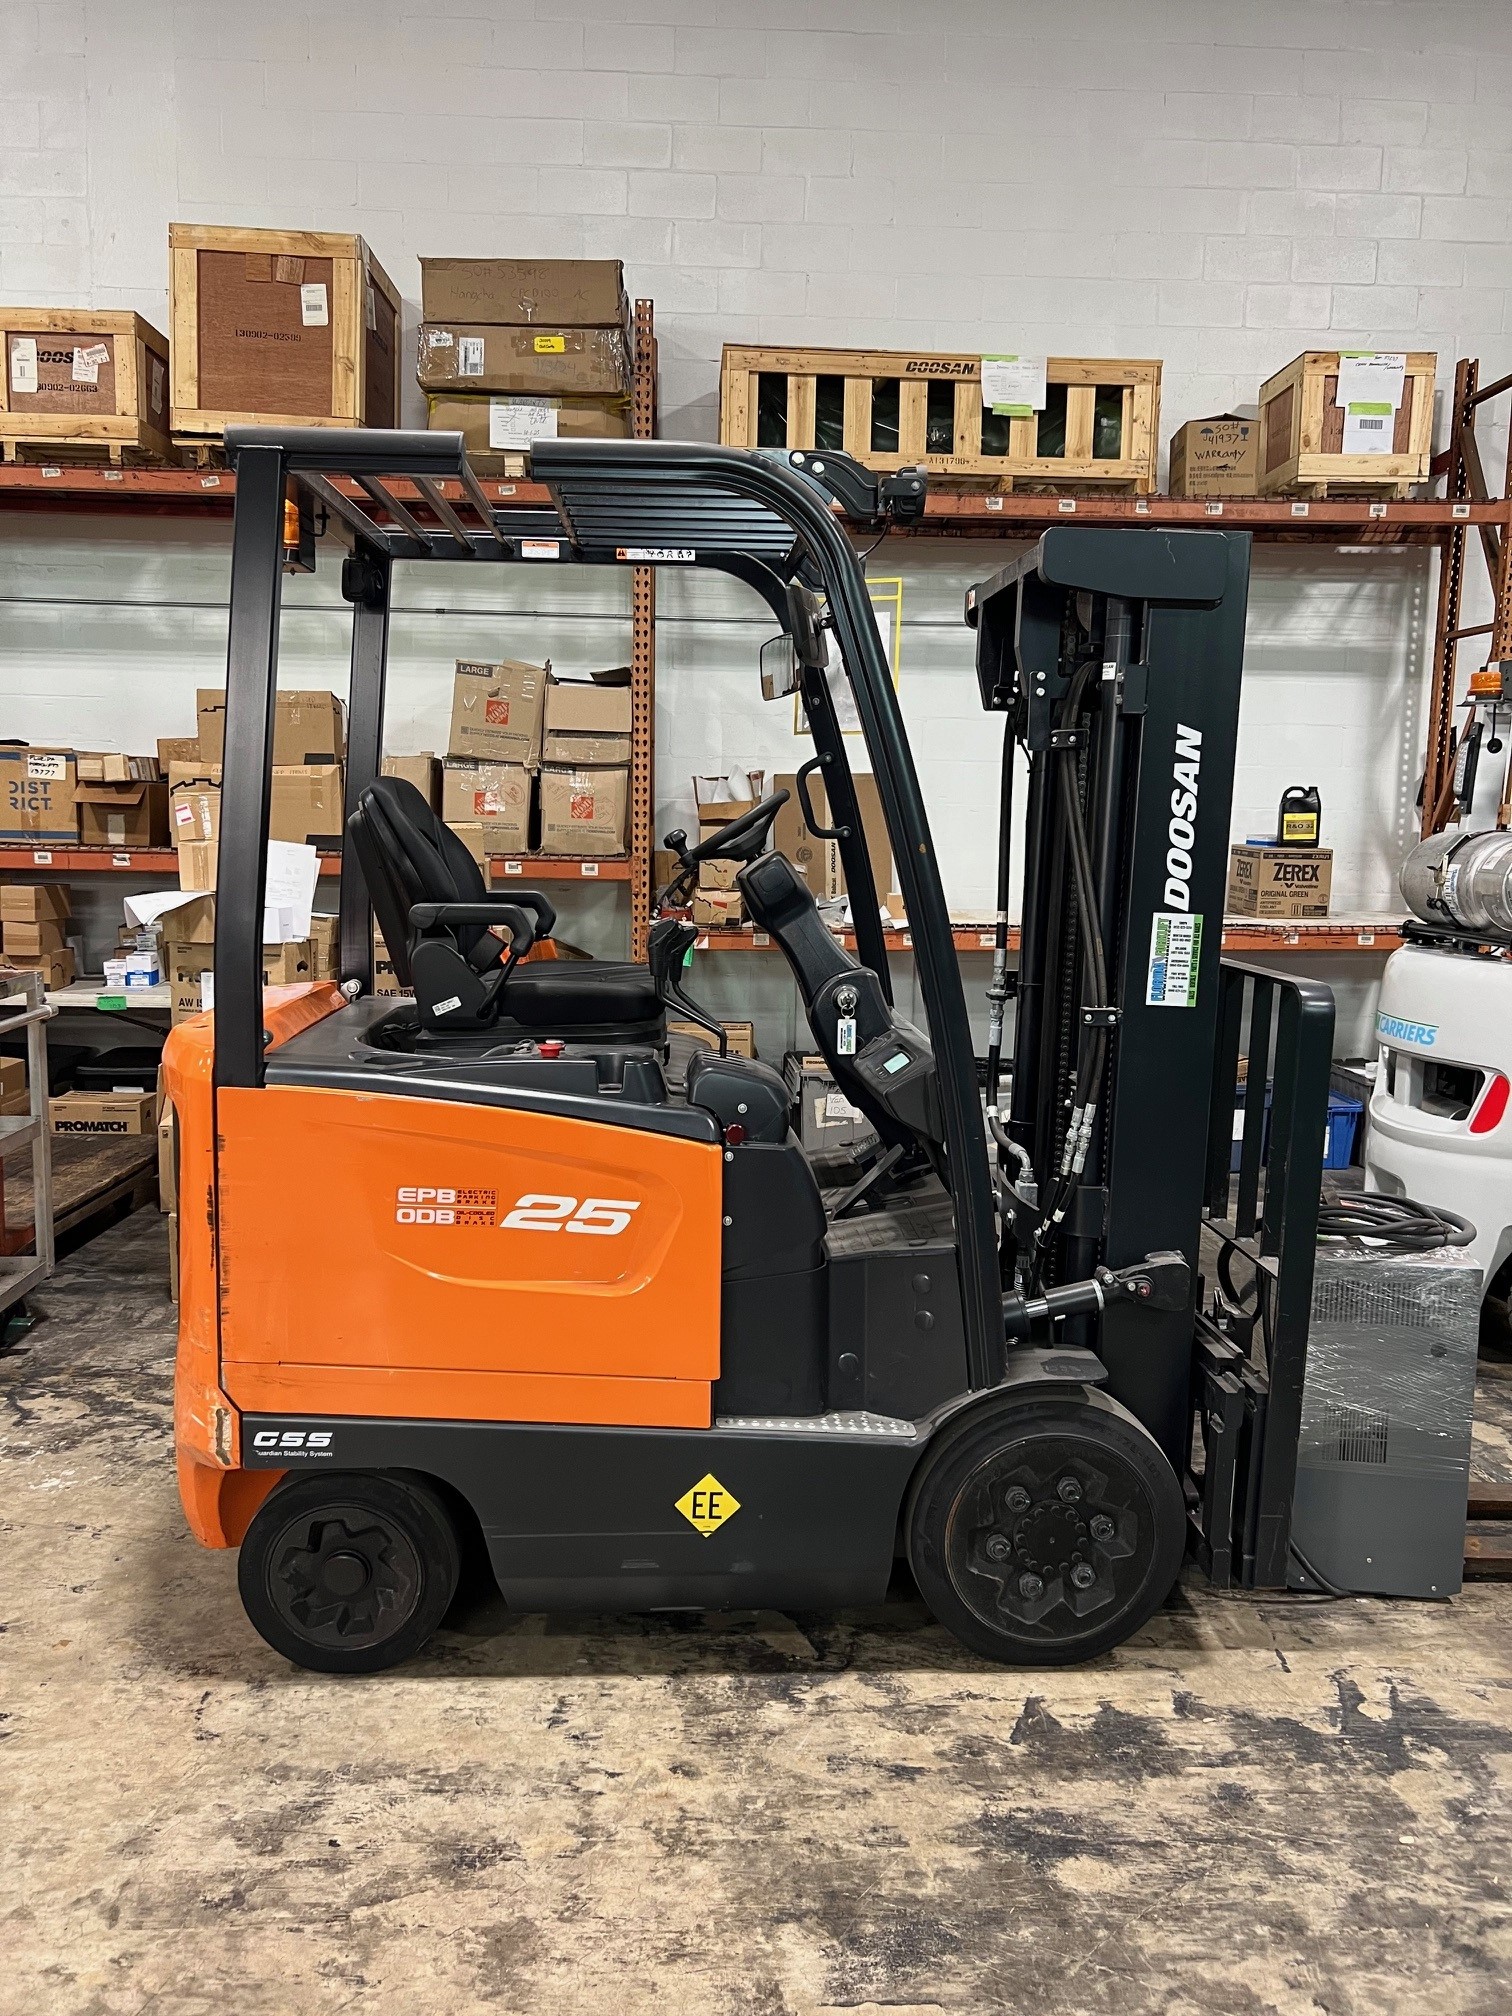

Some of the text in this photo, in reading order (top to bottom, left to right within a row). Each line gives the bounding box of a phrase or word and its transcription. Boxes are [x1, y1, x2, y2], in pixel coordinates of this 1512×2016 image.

[905, 361, 975, 375] DOOSAN
[1208, 434, 1240, 445] 41937
[460, 665, 490, 675] LARGE
[446, 761, 475, 769] LARGE
[9, 781, 51, 794] DIST
[1164, 722, 1203, 912] DOOSAN
[1236, 859, 1254, 879] ZEREX
[1272, 862, 1321, 882] ZEREX
[1260, 890, 1309, 898] ORIGINAL GREEN
[1150, 917, 1169, 1001] FLORIDA FORKLIFT
[377, 989, 397, 998] SAE
[178, 997, 194, 1007] AW
[1380, 1016, 1438, 1045] CARRIERS
[54, 1121, 128, 1132] PROMATCH
[397, 1187, 457, 1203] EPB
[396, 1208, 456, 1225] ODB
[499, 1193, 642, 1236] 25
[253, 1431, 334, 1447] GSS
[692, 1491, 723, 1519] EE
